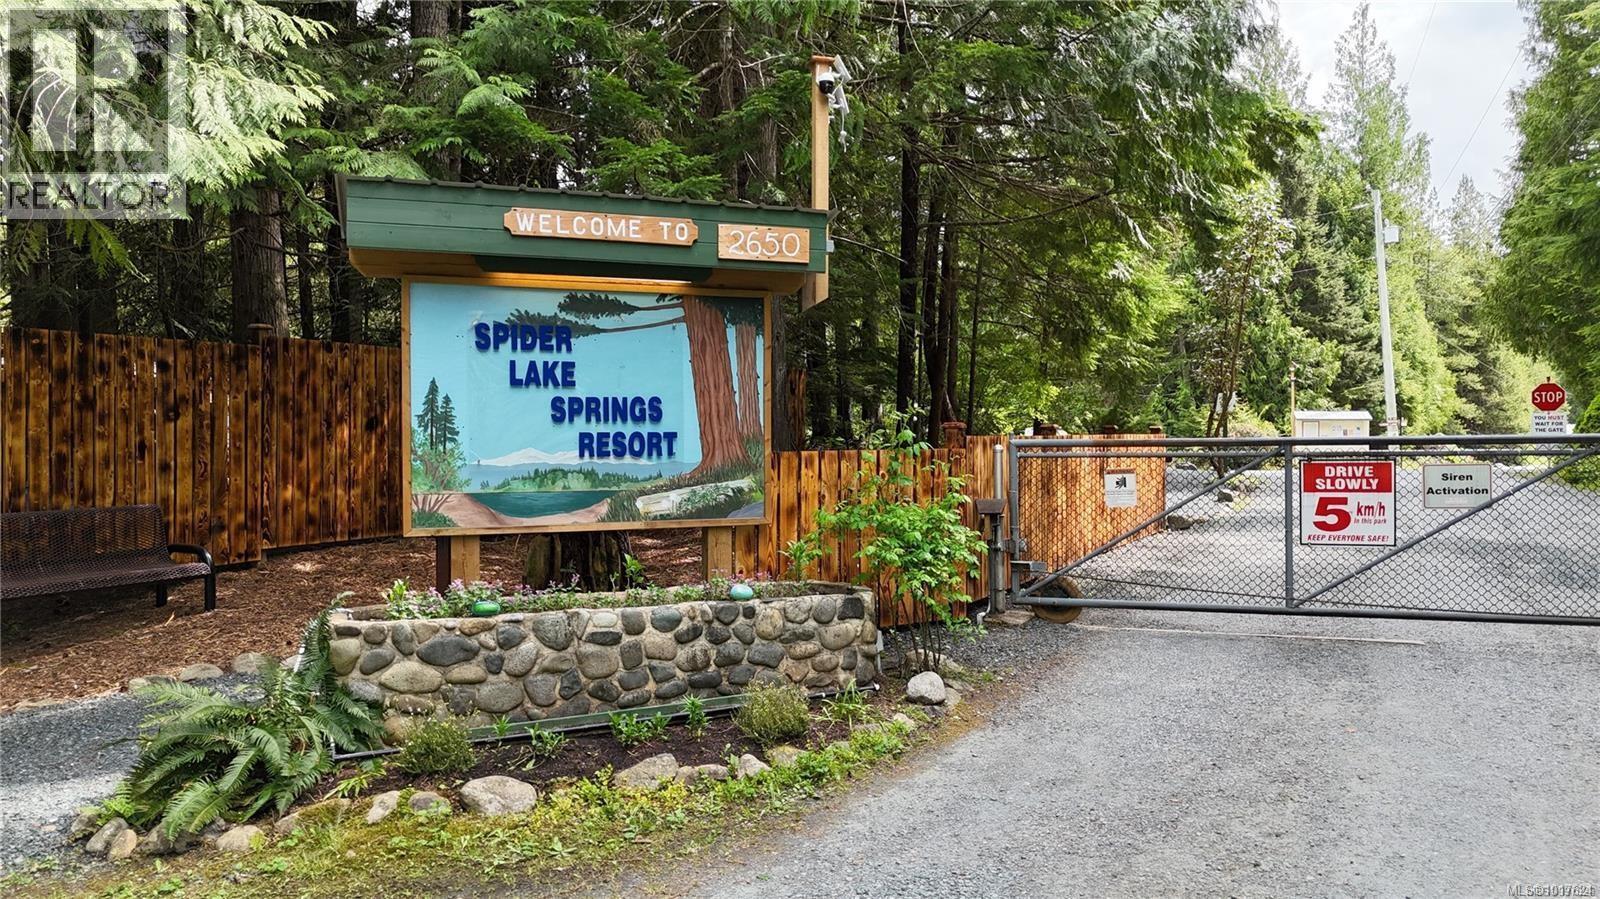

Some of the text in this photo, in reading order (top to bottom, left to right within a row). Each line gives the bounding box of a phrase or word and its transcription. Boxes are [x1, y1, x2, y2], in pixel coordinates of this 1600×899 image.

[516, 211, 689, 242] WELCOME TO
[727, 229, 802, 258] 2650
[474, 321, 574, 353] SPIDER
[509, 359, 577, 389] LAKE
[1533, 391, 1563, 403] STOP
[550, 395, 664, 424] SPRINGS
[578, 431, 678, 459] RESORT
[1324, 465, 1374, 478] DRIVE
[1441, 472, 1473, 481] Siren
[1315, 478, 1379, 490] SLOWLY
[1426, 486, 1489, 495] Activation
[1312, 497, 1386, 532] 5 km/h
[1373, 517, 1387, 526] park
[1307, 534, 1390, 543] KEEP EVERYONE SAFE!
